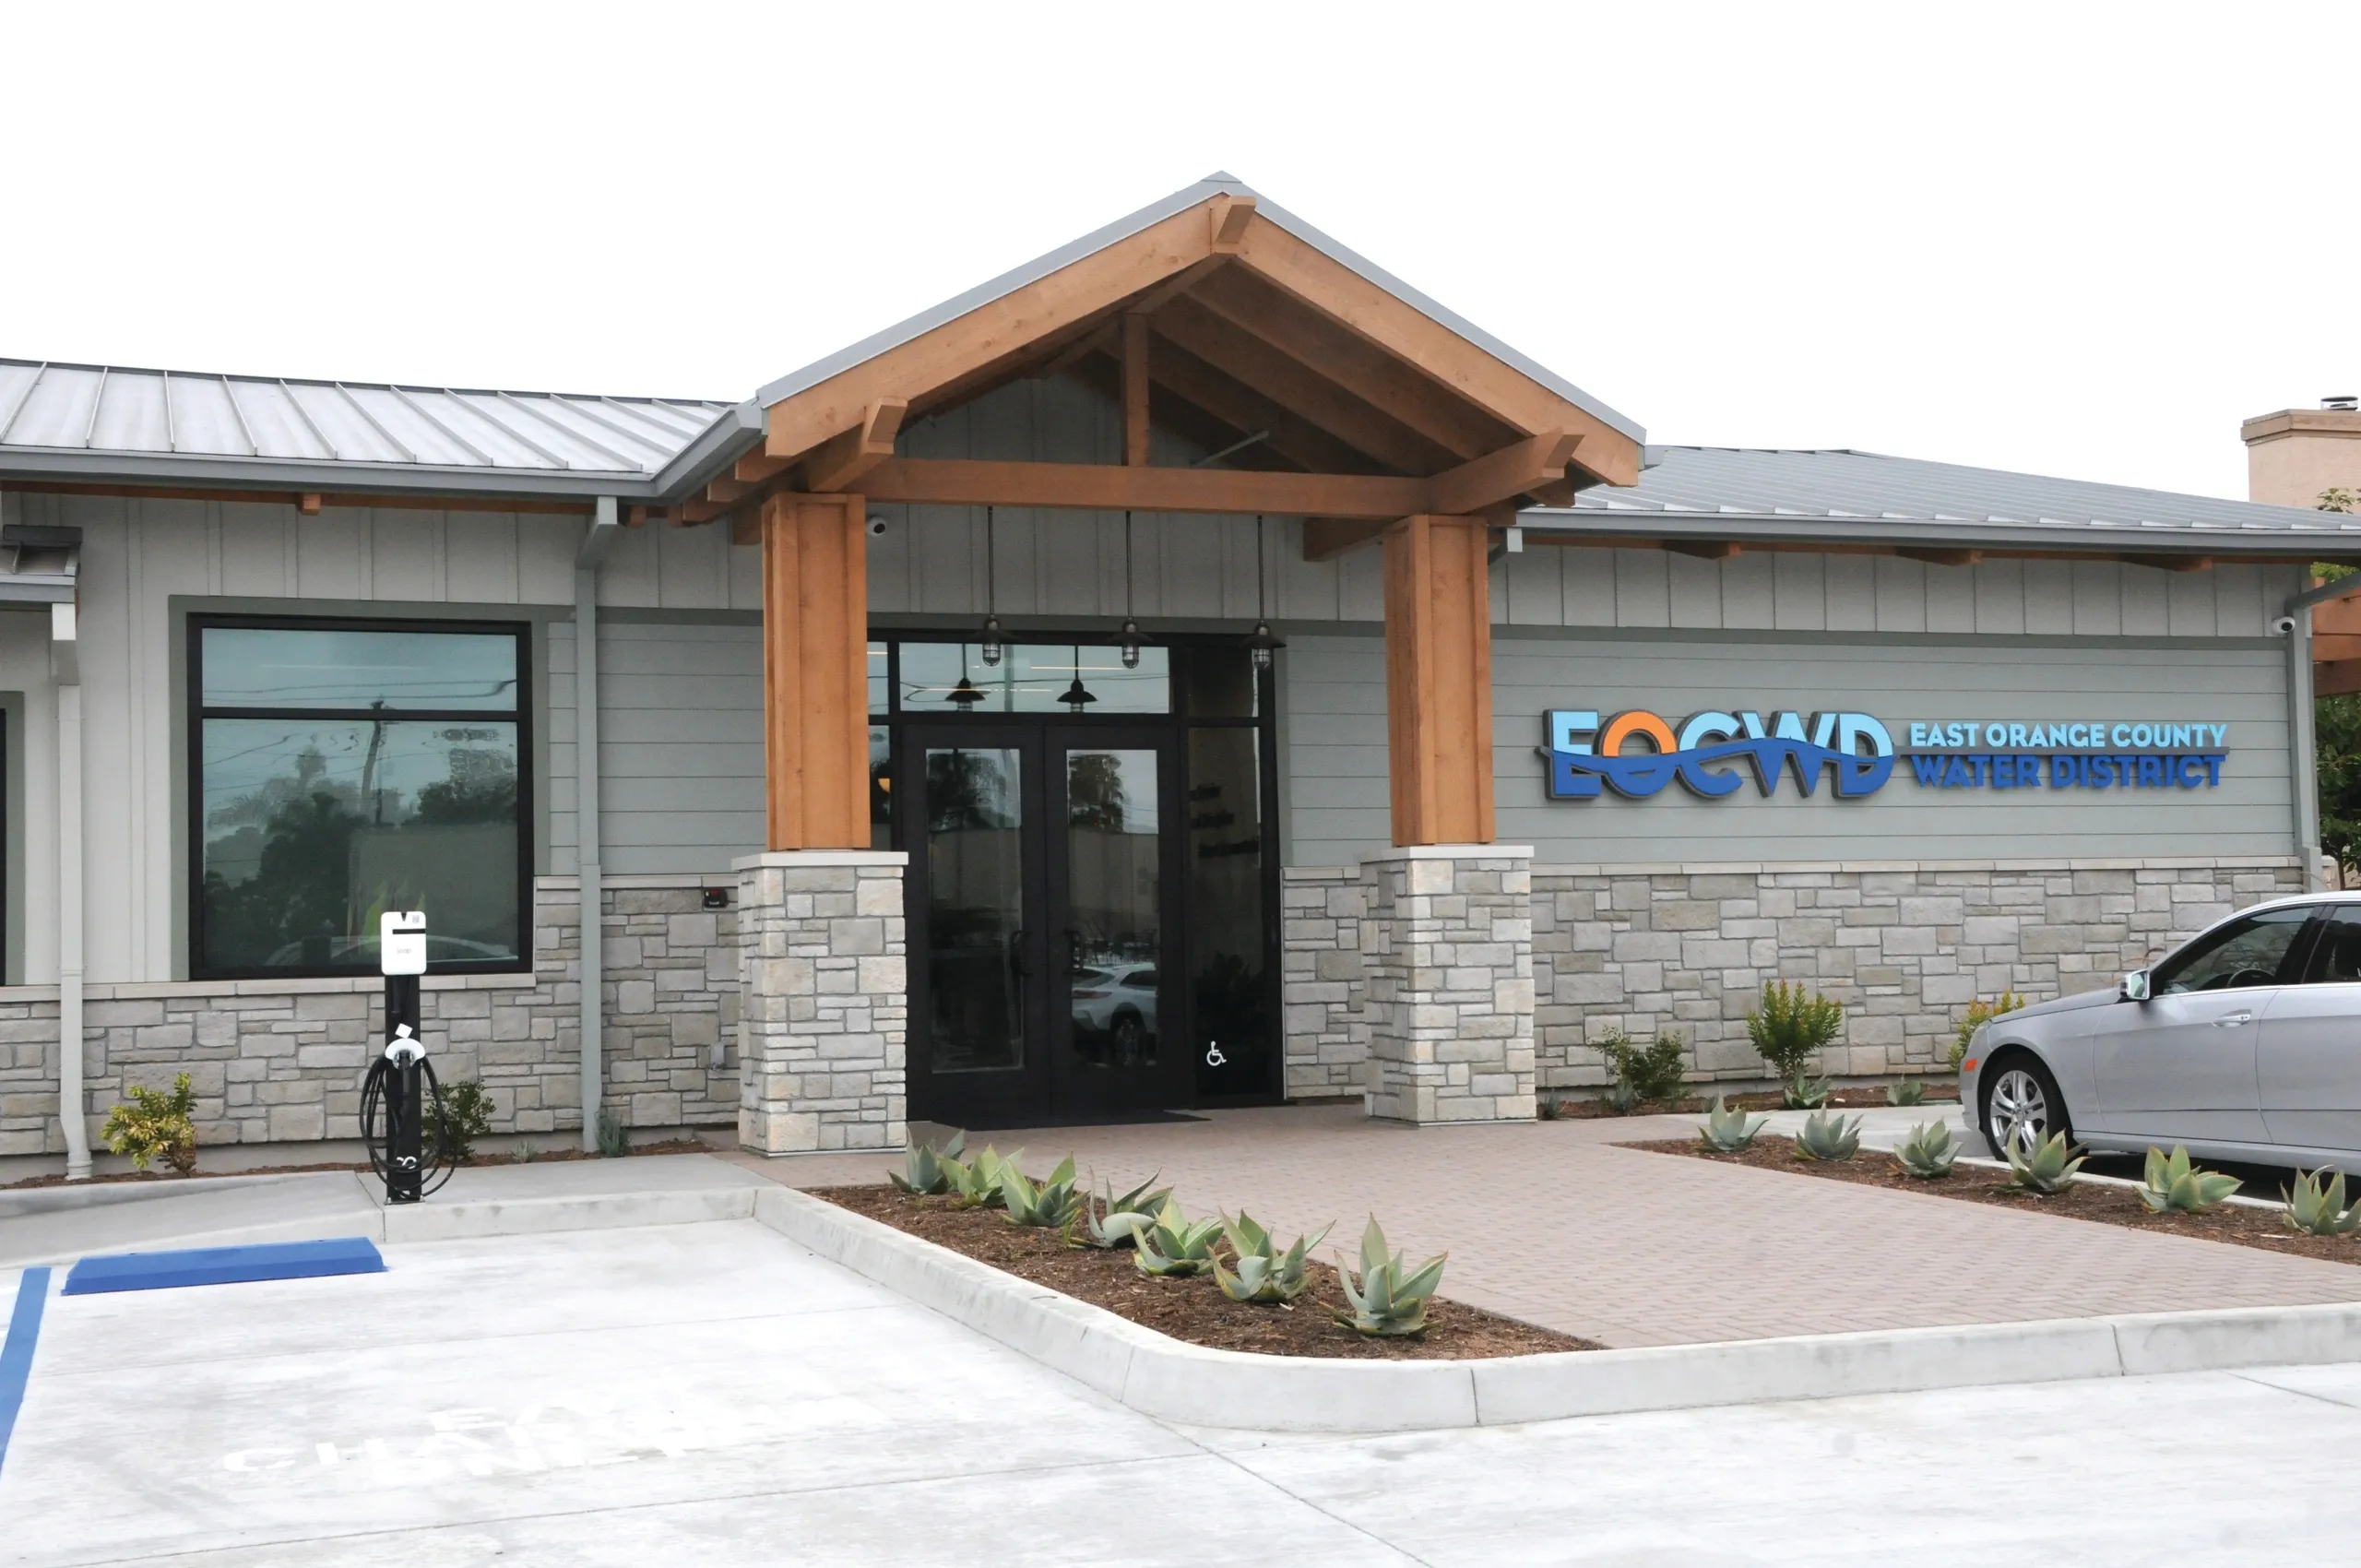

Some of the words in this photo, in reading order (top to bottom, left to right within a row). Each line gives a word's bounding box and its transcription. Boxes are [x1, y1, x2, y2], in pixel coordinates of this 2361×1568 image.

[1910, 722, 1980, 747] EAST
[1986, 722, 2106, 747] ORANGE
[2111, 722, 2227, 748] COUNTY
[1540, 710, 1895, 799] EOCWD
[1911, 754, 2041, 788] WATER
[2051, 754, 2226, 788] DISTRICT
